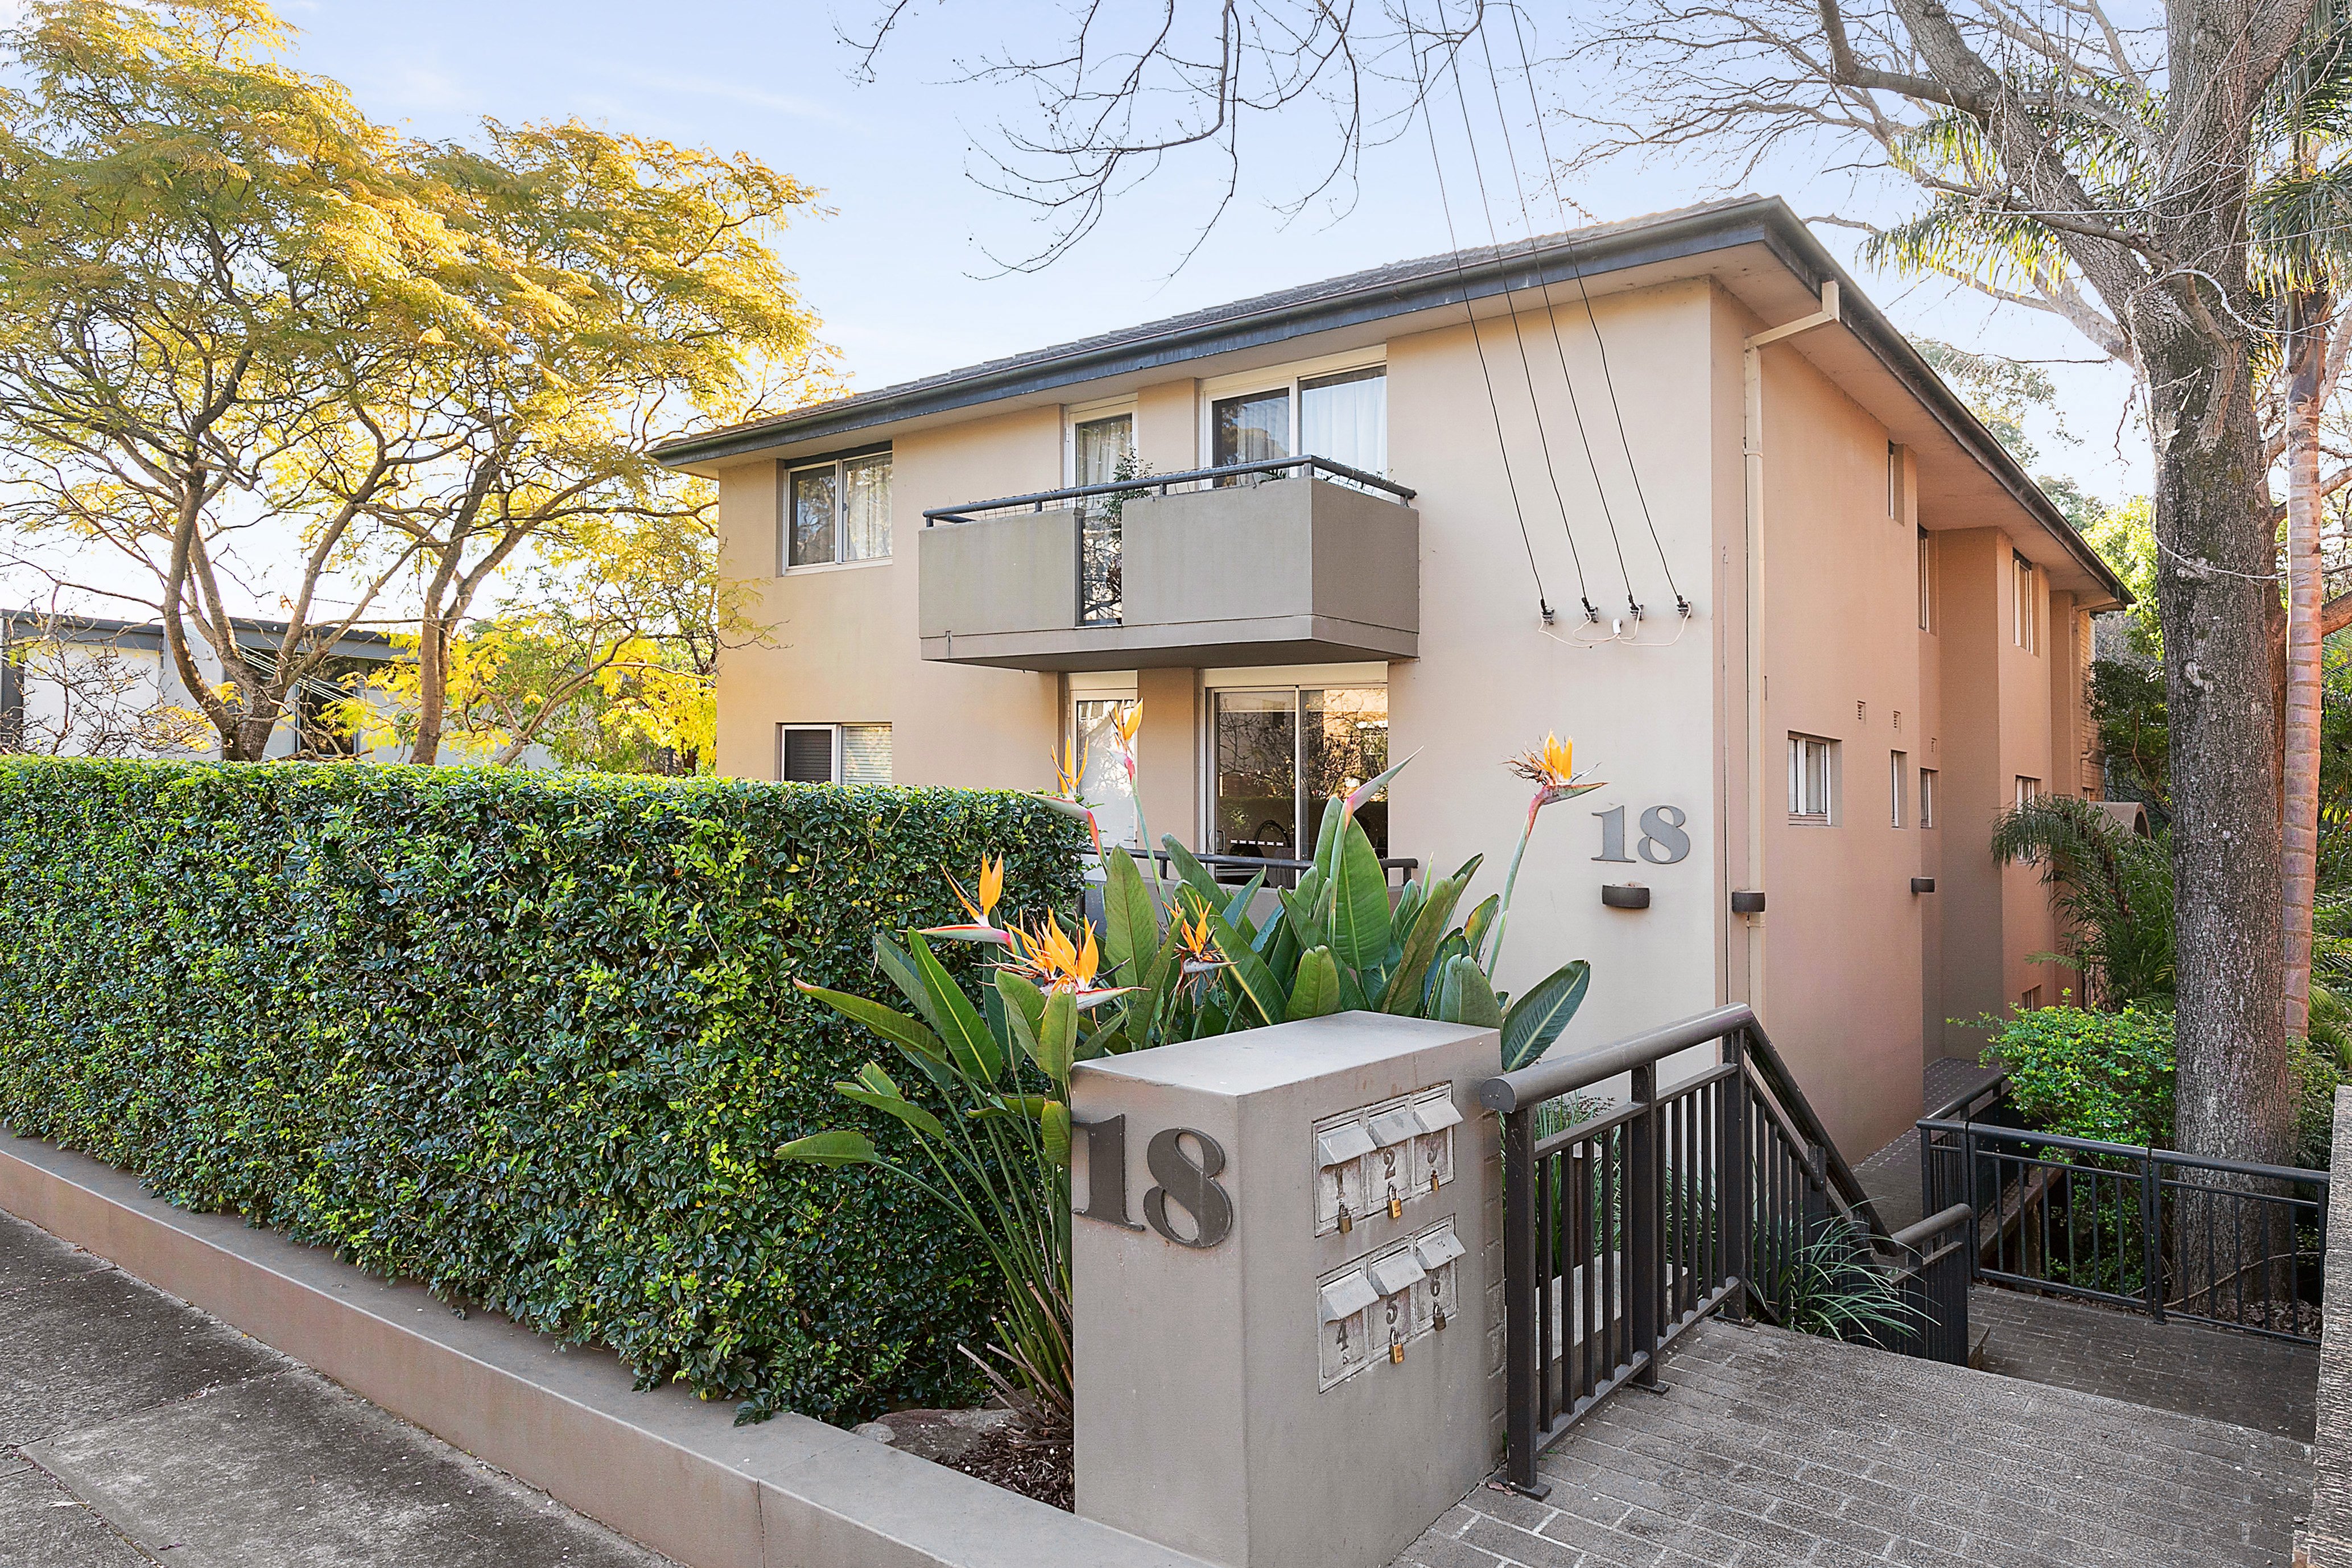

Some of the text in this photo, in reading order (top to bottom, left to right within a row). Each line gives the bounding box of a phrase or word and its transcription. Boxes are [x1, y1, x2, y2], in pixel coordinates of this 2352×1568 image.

[1591, 804, 1690, 864] 18
[1383, 1149, 1396, 1180] 2
[1071, 1113, 1233, 1248] 18
[1336, 1167, 1346, 1200] 1
[1430, 1269, 1441, 1297] 6
[1386, 1294, 1398, 1324] 5
[1336, 1320, 1349, 1351] 4
